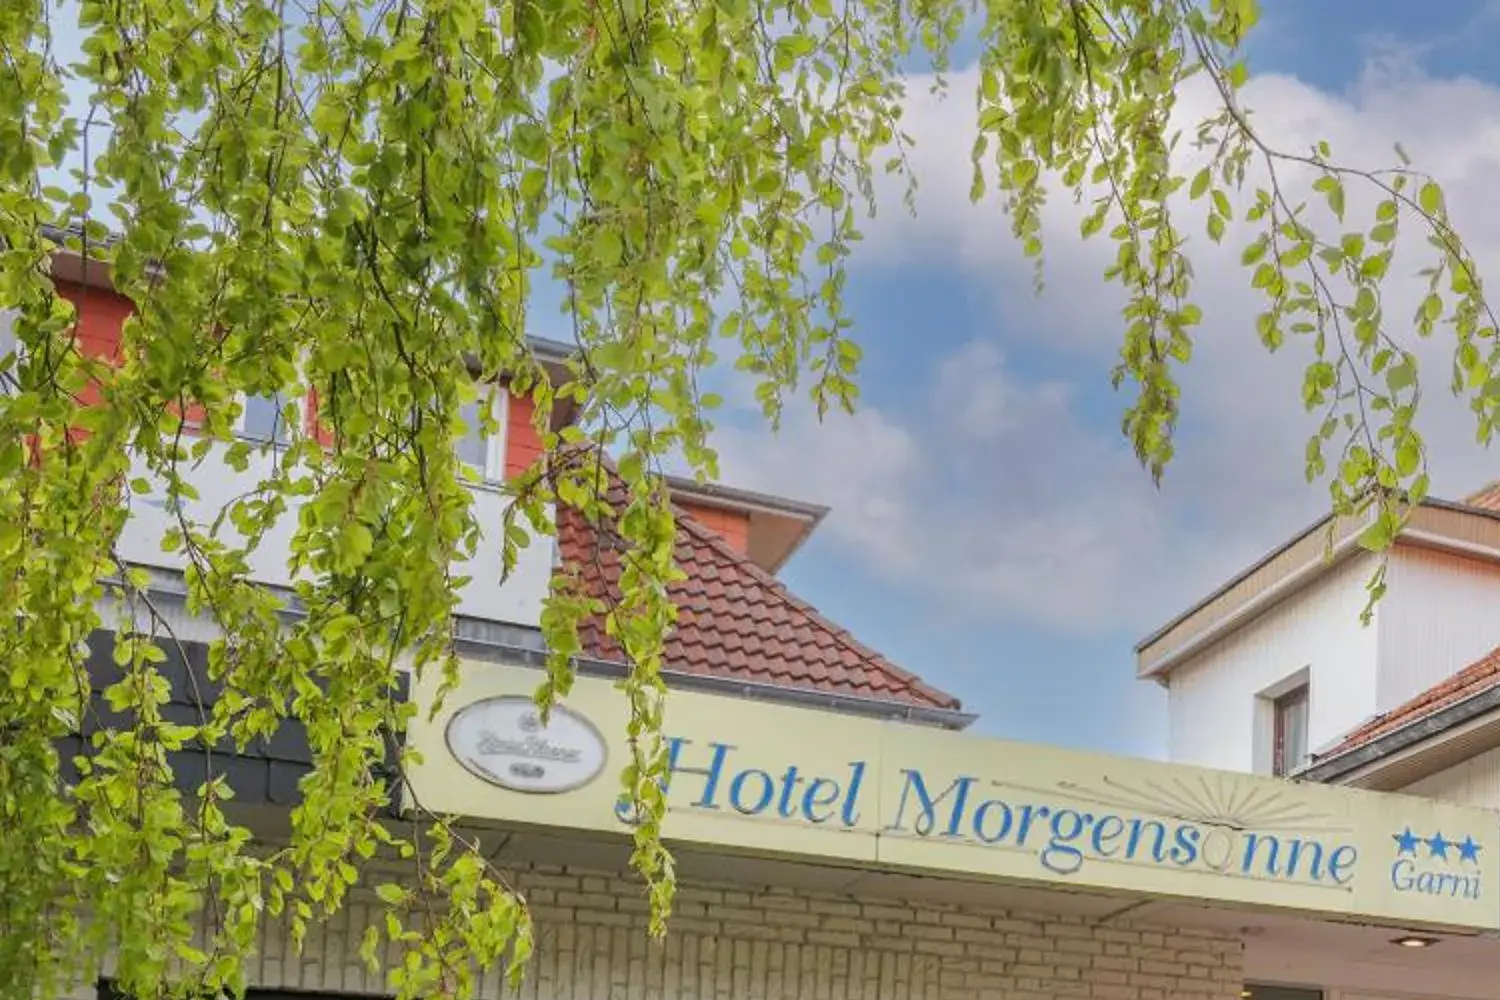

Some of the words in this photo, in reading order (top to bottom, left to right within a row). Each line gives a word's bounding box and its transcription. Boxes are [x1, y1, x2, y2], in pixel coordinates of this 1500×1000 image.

[614, 734, 867, 827] Hotel
[884, 768, 1359, 884] Morgensonne
[1391, 858, 1483, 901] Garni
